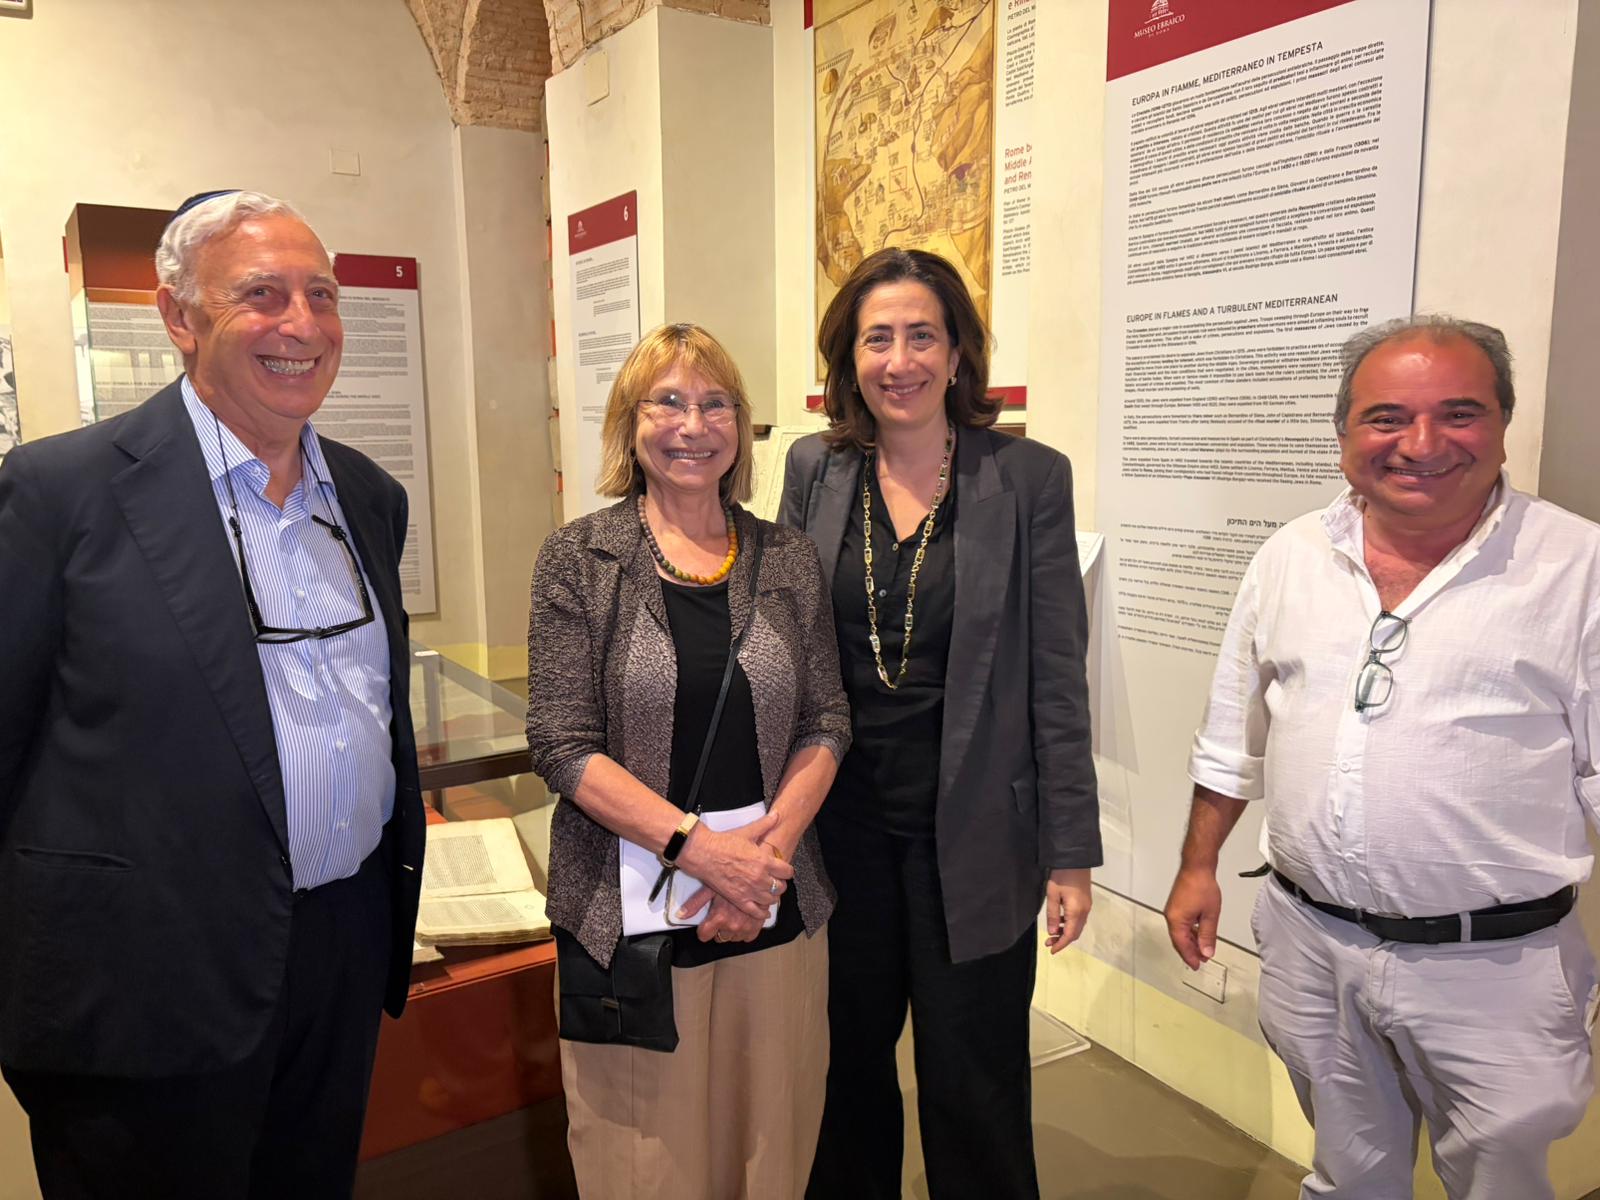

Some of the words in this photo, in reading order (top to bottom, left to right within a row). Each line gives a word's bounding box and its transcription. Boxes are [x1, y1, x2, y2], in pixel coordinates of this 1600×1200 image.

[1134, 24, 1156, 38] MUSEO
[1156, 14, 1185, 30] EBRAICO
[1132, 91, 1159, 105] EUROPA
[1161, 88, 1169, 96] IN
[1170, 78, 1200, 93] FIAMME,
[1203, 59, 1263, 83] MEDITERRANEO
[1266, 55, 1274, 64] IN
[1278, 42, 1322, 60] TEMPESTA
[1005, 146, 1024, 158] Rome
[1005, 158, 1026, 171] Middle
[1004, 174, 1016, 184] and
[624, 205, 628, 221] 6
[396, 266, 402, 278] 5
[1126, 313, 1152, 322] EUROPE
[1163, 309, 1190, 318] FLAMES
[1192, 307, 1207, 315] AND
[1217, 301, 1261, 313] TURBULENT
[1265, 294, 1337, 308] MEDITERRANEAN
[1226, 518, 1248, 526] התיכון
[1263, 520, 1277, 528] מעל
